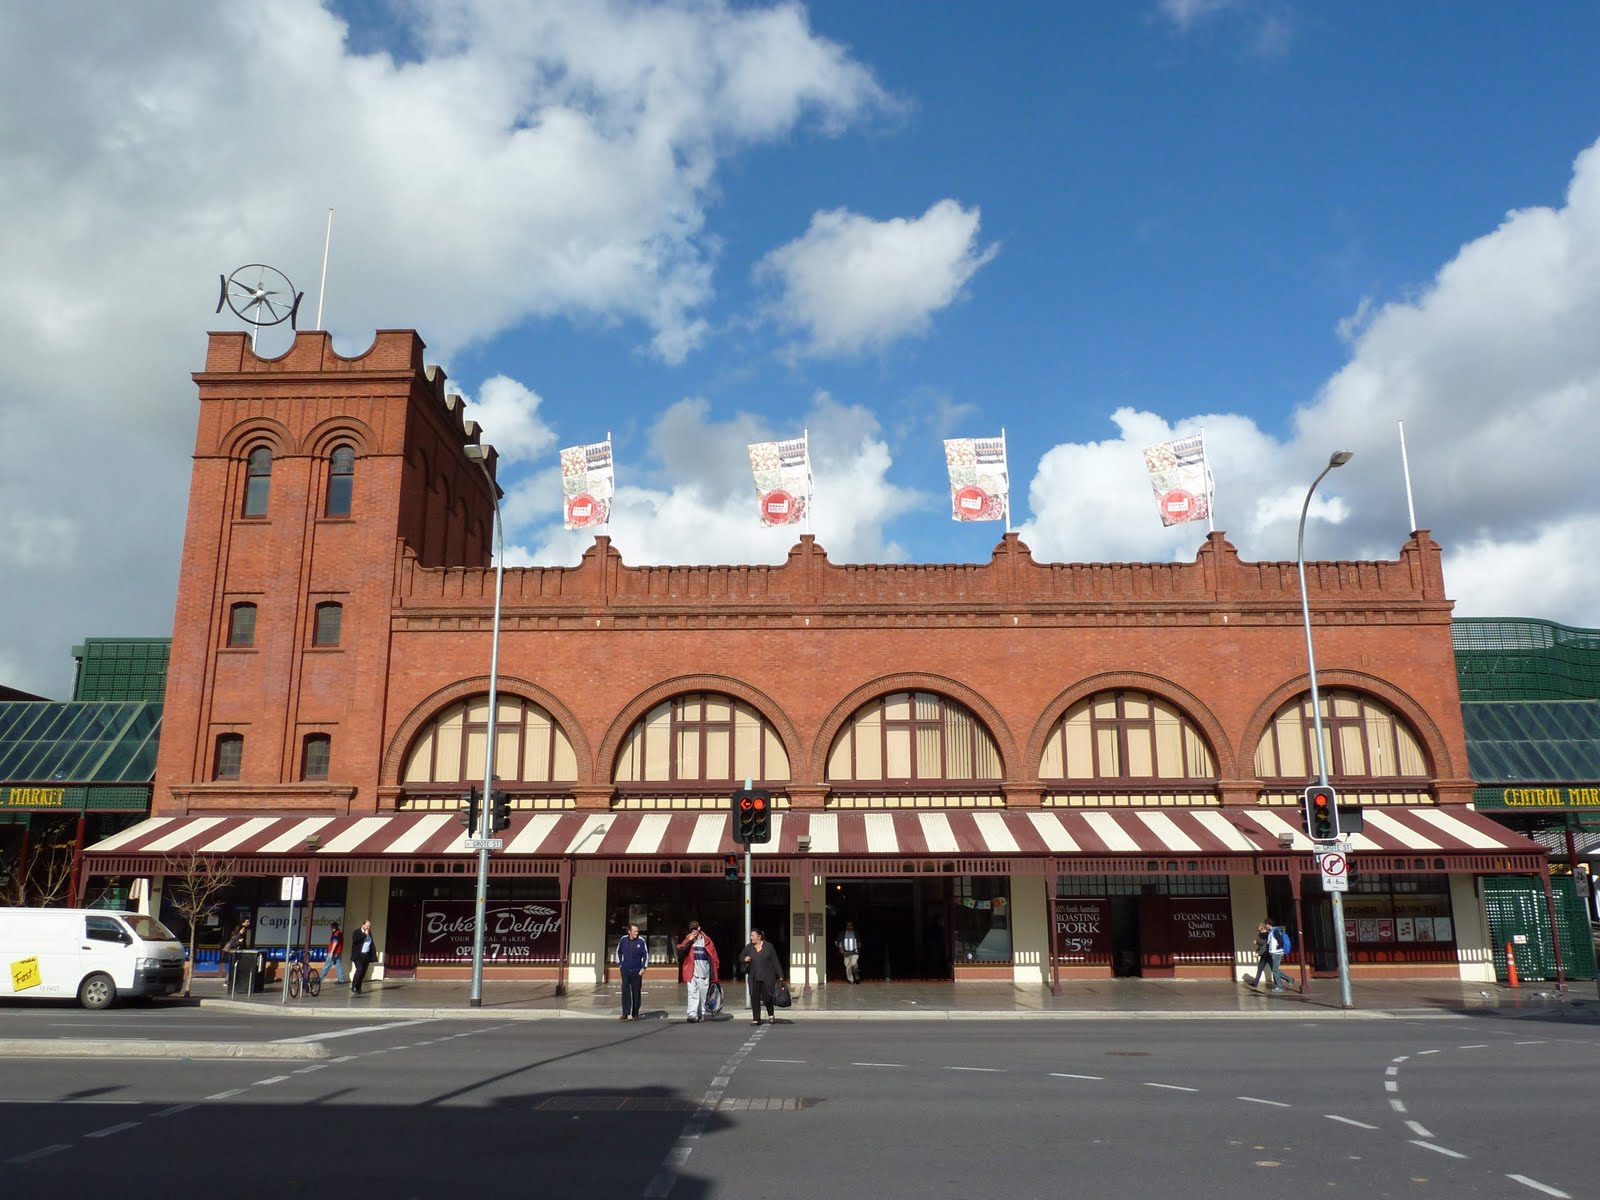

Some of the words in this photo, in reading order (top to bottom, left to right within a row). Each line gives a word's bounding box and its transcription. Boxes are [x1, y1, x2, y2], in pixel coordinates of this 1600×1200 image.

[8, 788, 65, 805] MARKET
[1503, 788, 1565, 806] CENTRAL
[1568, 788, 1600, 805] MAR
[260, 915, 297, 928] Cappo
[1056, 913, 1100, 922] ROASTING
[1173, 913, 1227, 921] O'CONNELL'S
[426, 912, 487, 934] Bakes
[495, 912, 561, 940] Delight
[1057, 922, 1101, 934] PORK
[1188, 921, 1213, 929] Quality
[1188, 930, 1216, 938] MEATS
[490, 943, 501, 959] 7
[503, 945, 530, 956] DAYS
